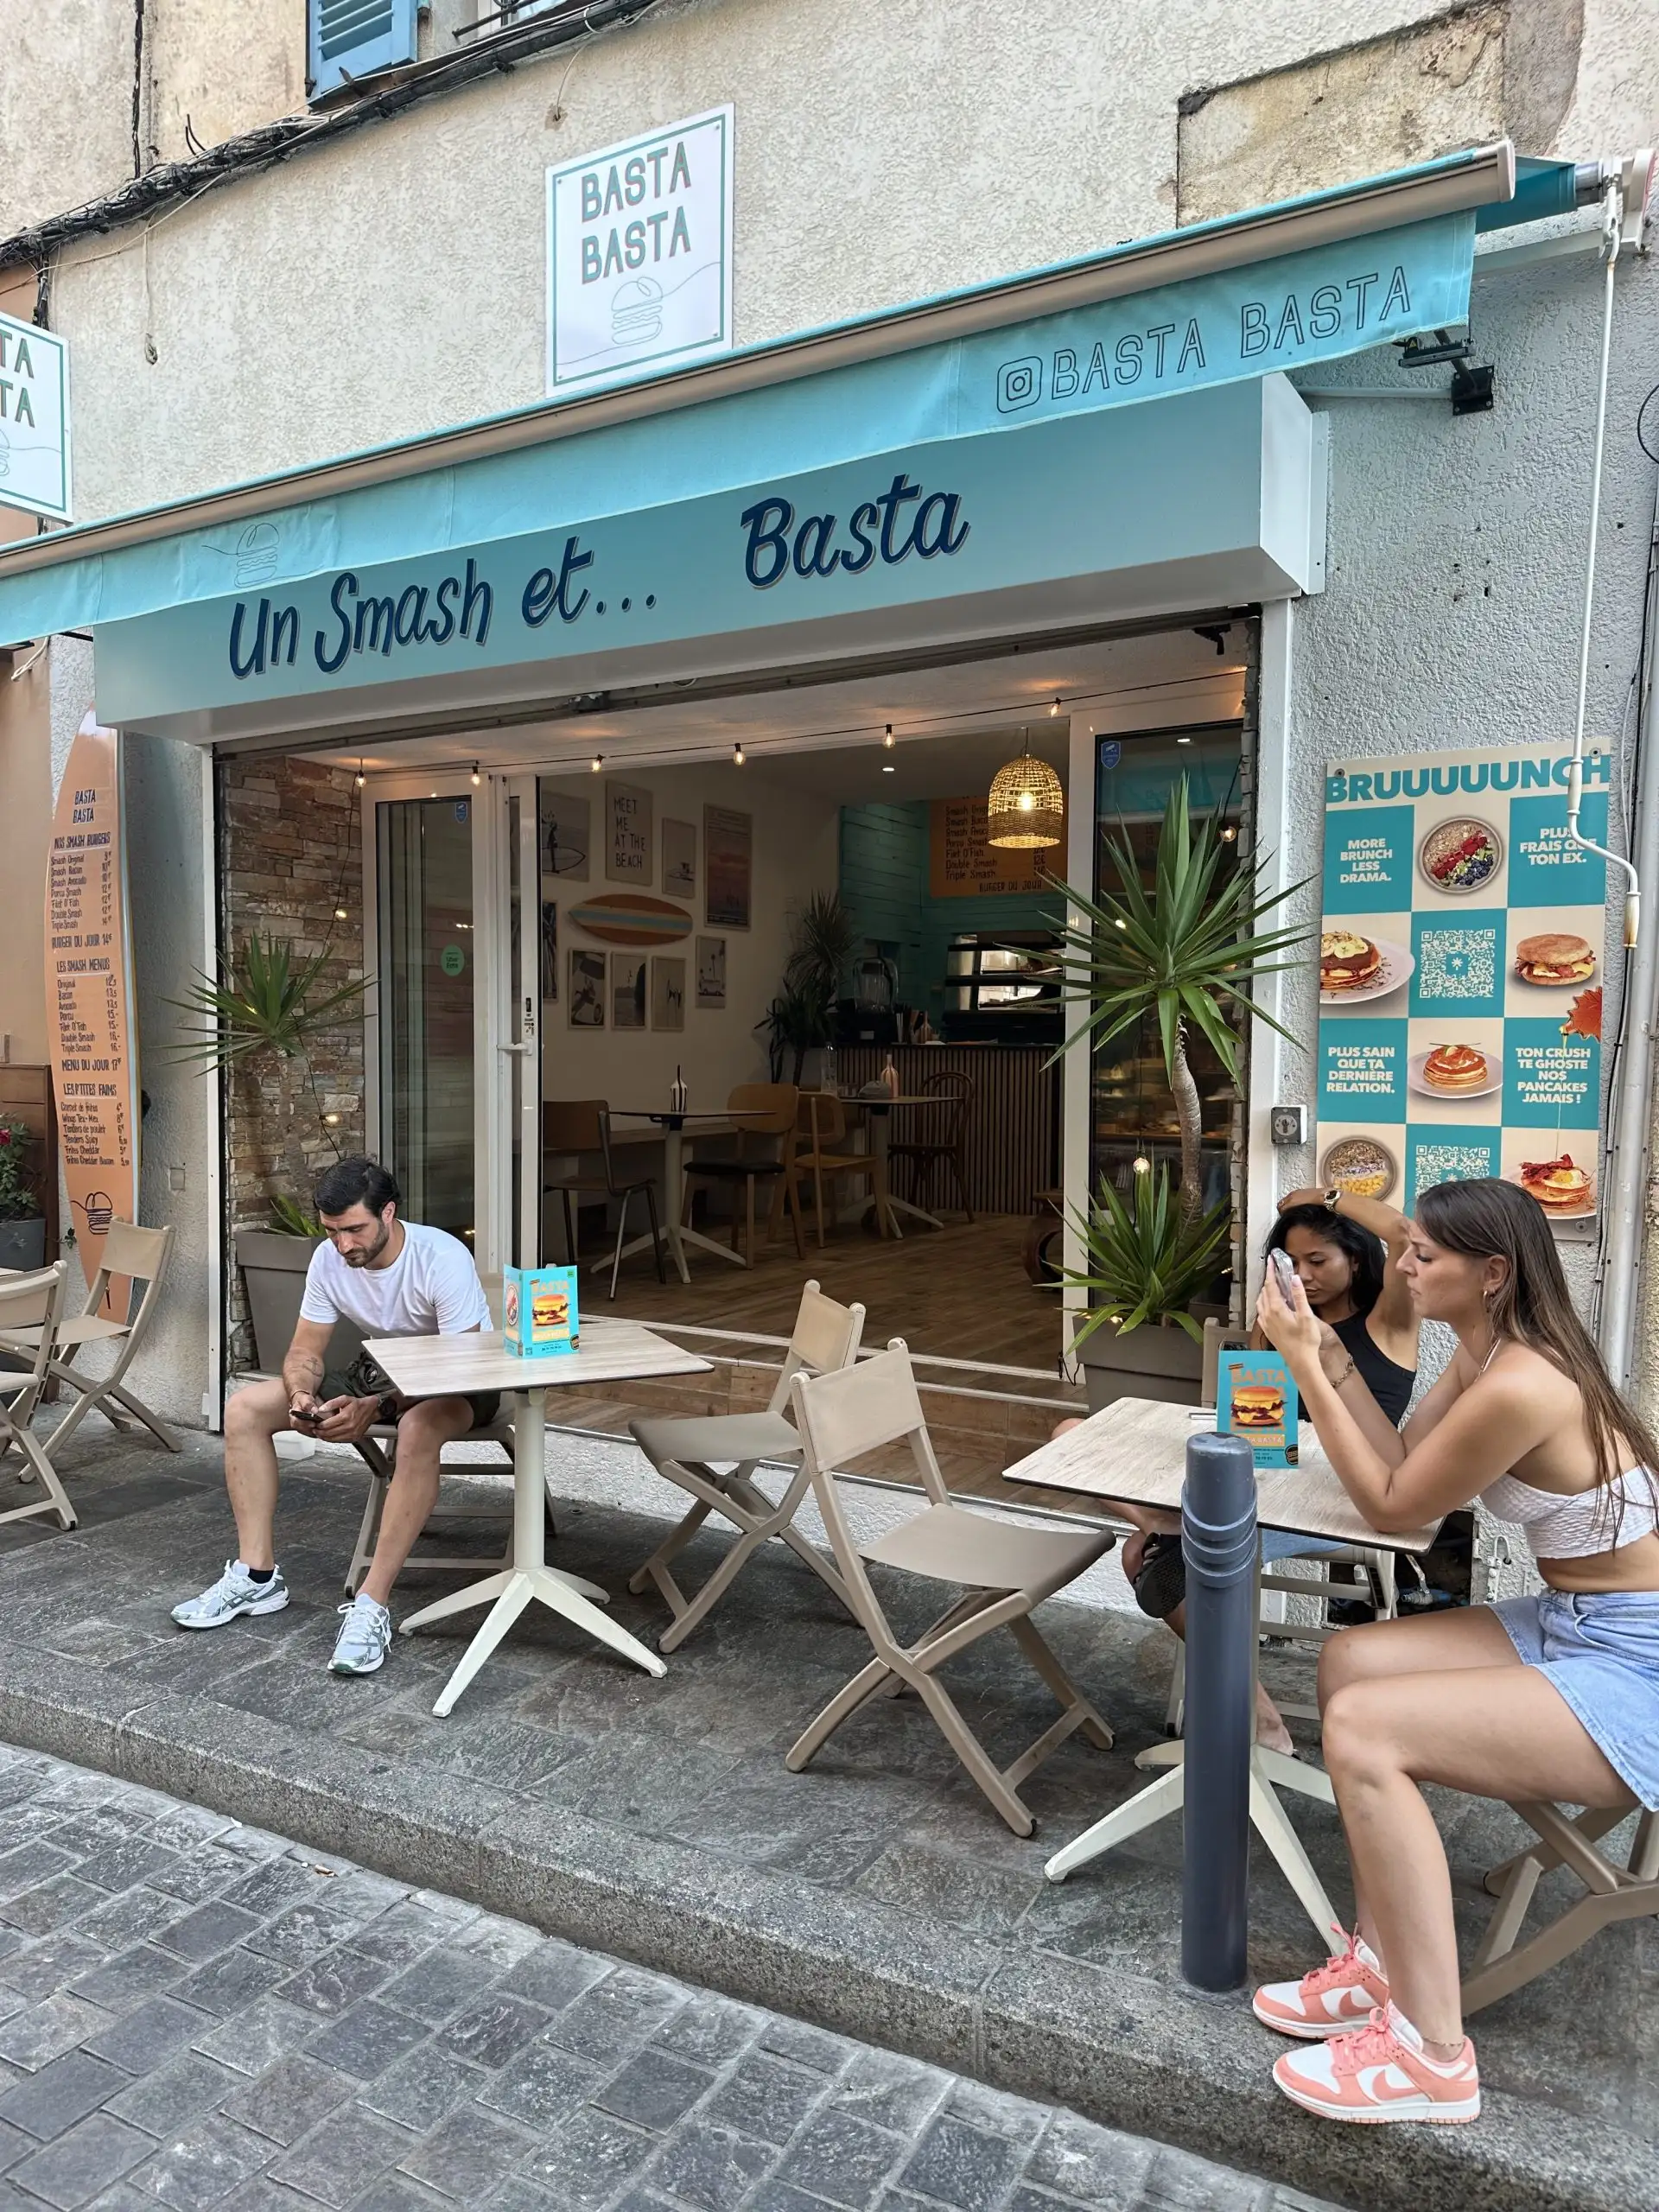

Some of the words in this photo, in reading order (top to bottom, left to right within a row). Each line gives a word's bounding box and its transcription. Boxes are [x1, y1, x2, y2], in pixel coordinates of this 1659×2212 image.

[582, 141, 691, 223] BASTA
[582, 206, 691, 285] BASTA
[1051, 318, 1206, 400] BASTA
[1240, 265, 1411, 359] BASTA
[229, 598, 300, 679] Un
[314, 557, 493, 674] Smash
[522, 536, 658, 628] et...
[741, 473, 970, 589] Basta
[74, 788, 96, 805] BASTA
[613, 796, 638, 814] MEET
[73, 808, 94, 823] BASTA
[615, 816, 629, 831] ME
[54, 836, 65, 849] NOS
[67, 834, 85, 848] SMASH
[87, 831, 111, 846] BURGERS
[614, 832, 626, 848] AT
[629, 833, 646, 852] THE
[1348, 838, 1386, 849] MORE
[1520, 840, 1562, 853] FRAIS
[615, 852, 642, 869] BEACH
[1340, 849, 1393, 861] BRUNCH
[1528, 853, 1560, 866] TON
[1562, 852, 1587, 864] EX.
[1352, 861, 1380, 872] LESS
[945, 870, 966, 881] Triple
[970, 869, 995, 880] Smash
[1340, 871, 1392, 883] DRAMA.
[1008, 881, 1018, 891] DU
[52, 936, 72, 949] BURGER
[74, 935, 82, 947] DU
[85, 934, 99, 947] JOUR
[56, 960, 67, 973] LES
[67, 958, 86, 972] SMASH
[89, 957, 110, 971] MENUS
[1328, 1046, 1361, 1058] PLUS
[1363, 1046, 1395, 1058] SAIN
[1516, 1047, 1543, 1058] TON
[1545, 1047, 1591, 1058] CRUSH
[61, 1058, 79, 1071] MENU
[81, 1058, 90, 1071] DU
[92, 1058, 110, 1071] JOUR
[1337, 1058, 1366, 1069] QUE
[1367, 1058, 1385, 1070] TA
[1517, 1058, 1533, 1069] TE
[1535, 1058, 1588, 1070] GHOSTE
[1328, 1068, 1394, 1081] DERNIÈRE
[1538, 1071, 1567, 1080] NOS
[63, 1083, 74, 1096] LES
[99, 1084, 117, 1096] FAIMS
[1326, 1082, 1395, 1094] RELATION.
[1517, 1081, 1588, 1092] PANCAKES
[1522, 1092, 1574, 1103] JAMAIS
[1576, 1094, 1581, 1103] !
